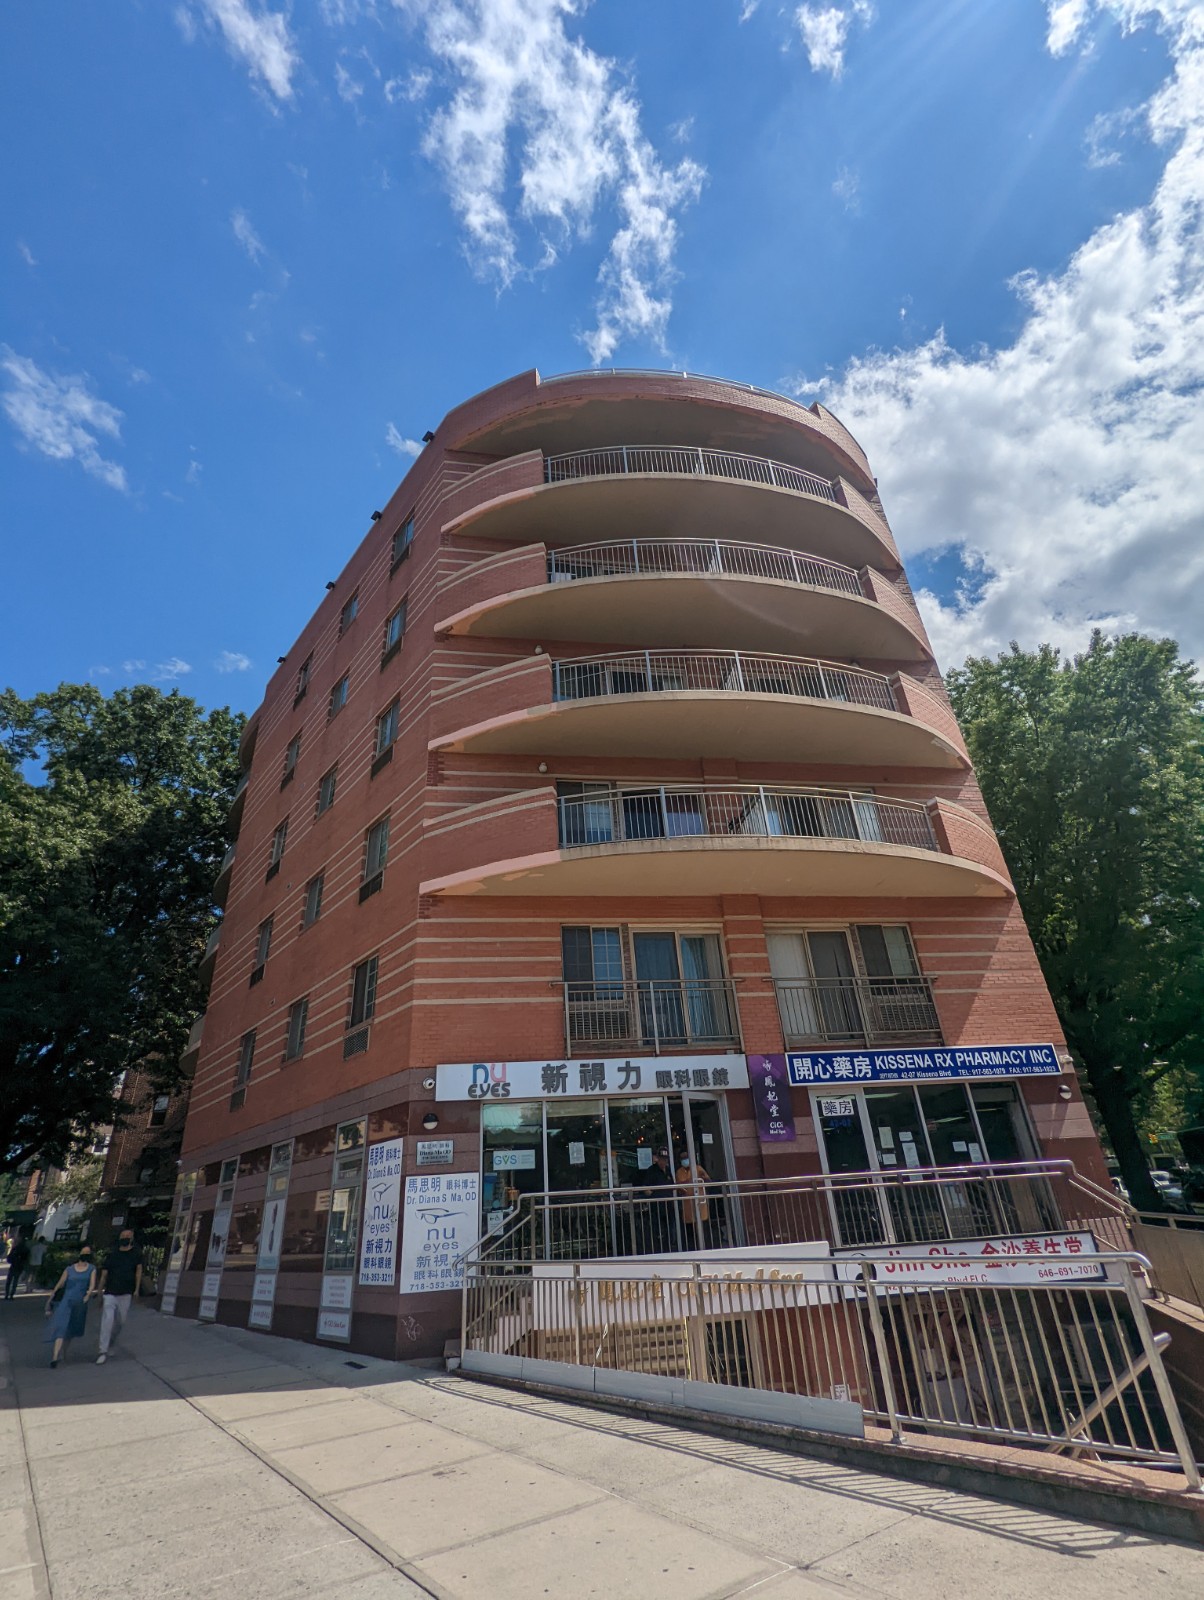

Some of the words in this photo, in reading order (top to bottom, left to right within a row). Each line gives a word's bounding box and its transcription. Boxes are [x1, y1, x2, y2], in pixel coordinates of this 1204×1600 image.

[874, 1054, 934, 1070] KISSENA
[934, 1052, 954, 1067] RX
[955, 1050, 1028, 1066] PHARMACY
[1029, 1049, 1052, 1063] INC
[472, 1063, 507, 1084] nu
[793, 1056, 872, 1081] 開心藥房
[541, 1061, 642, 1093] 新視力
[656, 1068, 730, 1088] 眼科眼鏡
[823, 1101, 852, 1115] 藥房
[493, 1154, 518, 1166] GVS
[407, 1177, 441, 1193] 馬思明
[446, 1179, 477, 1190] 眼科博士
[407, 1196, 417, 1205] Dr.
[419, 1195, 440, 1204] Diana
[465, 1192, 477, 1201] OD
[373, 1204, 390, 1220] nu
[370, 1223, 391, 1236] eyes
[427, 1227, 456, 1240] nu
[365, 1238, 393, 1255] 新視力
[423, 1241, 460, 1253] eyes
[1038, 1264, 1099, 1279] 646-691-7070
